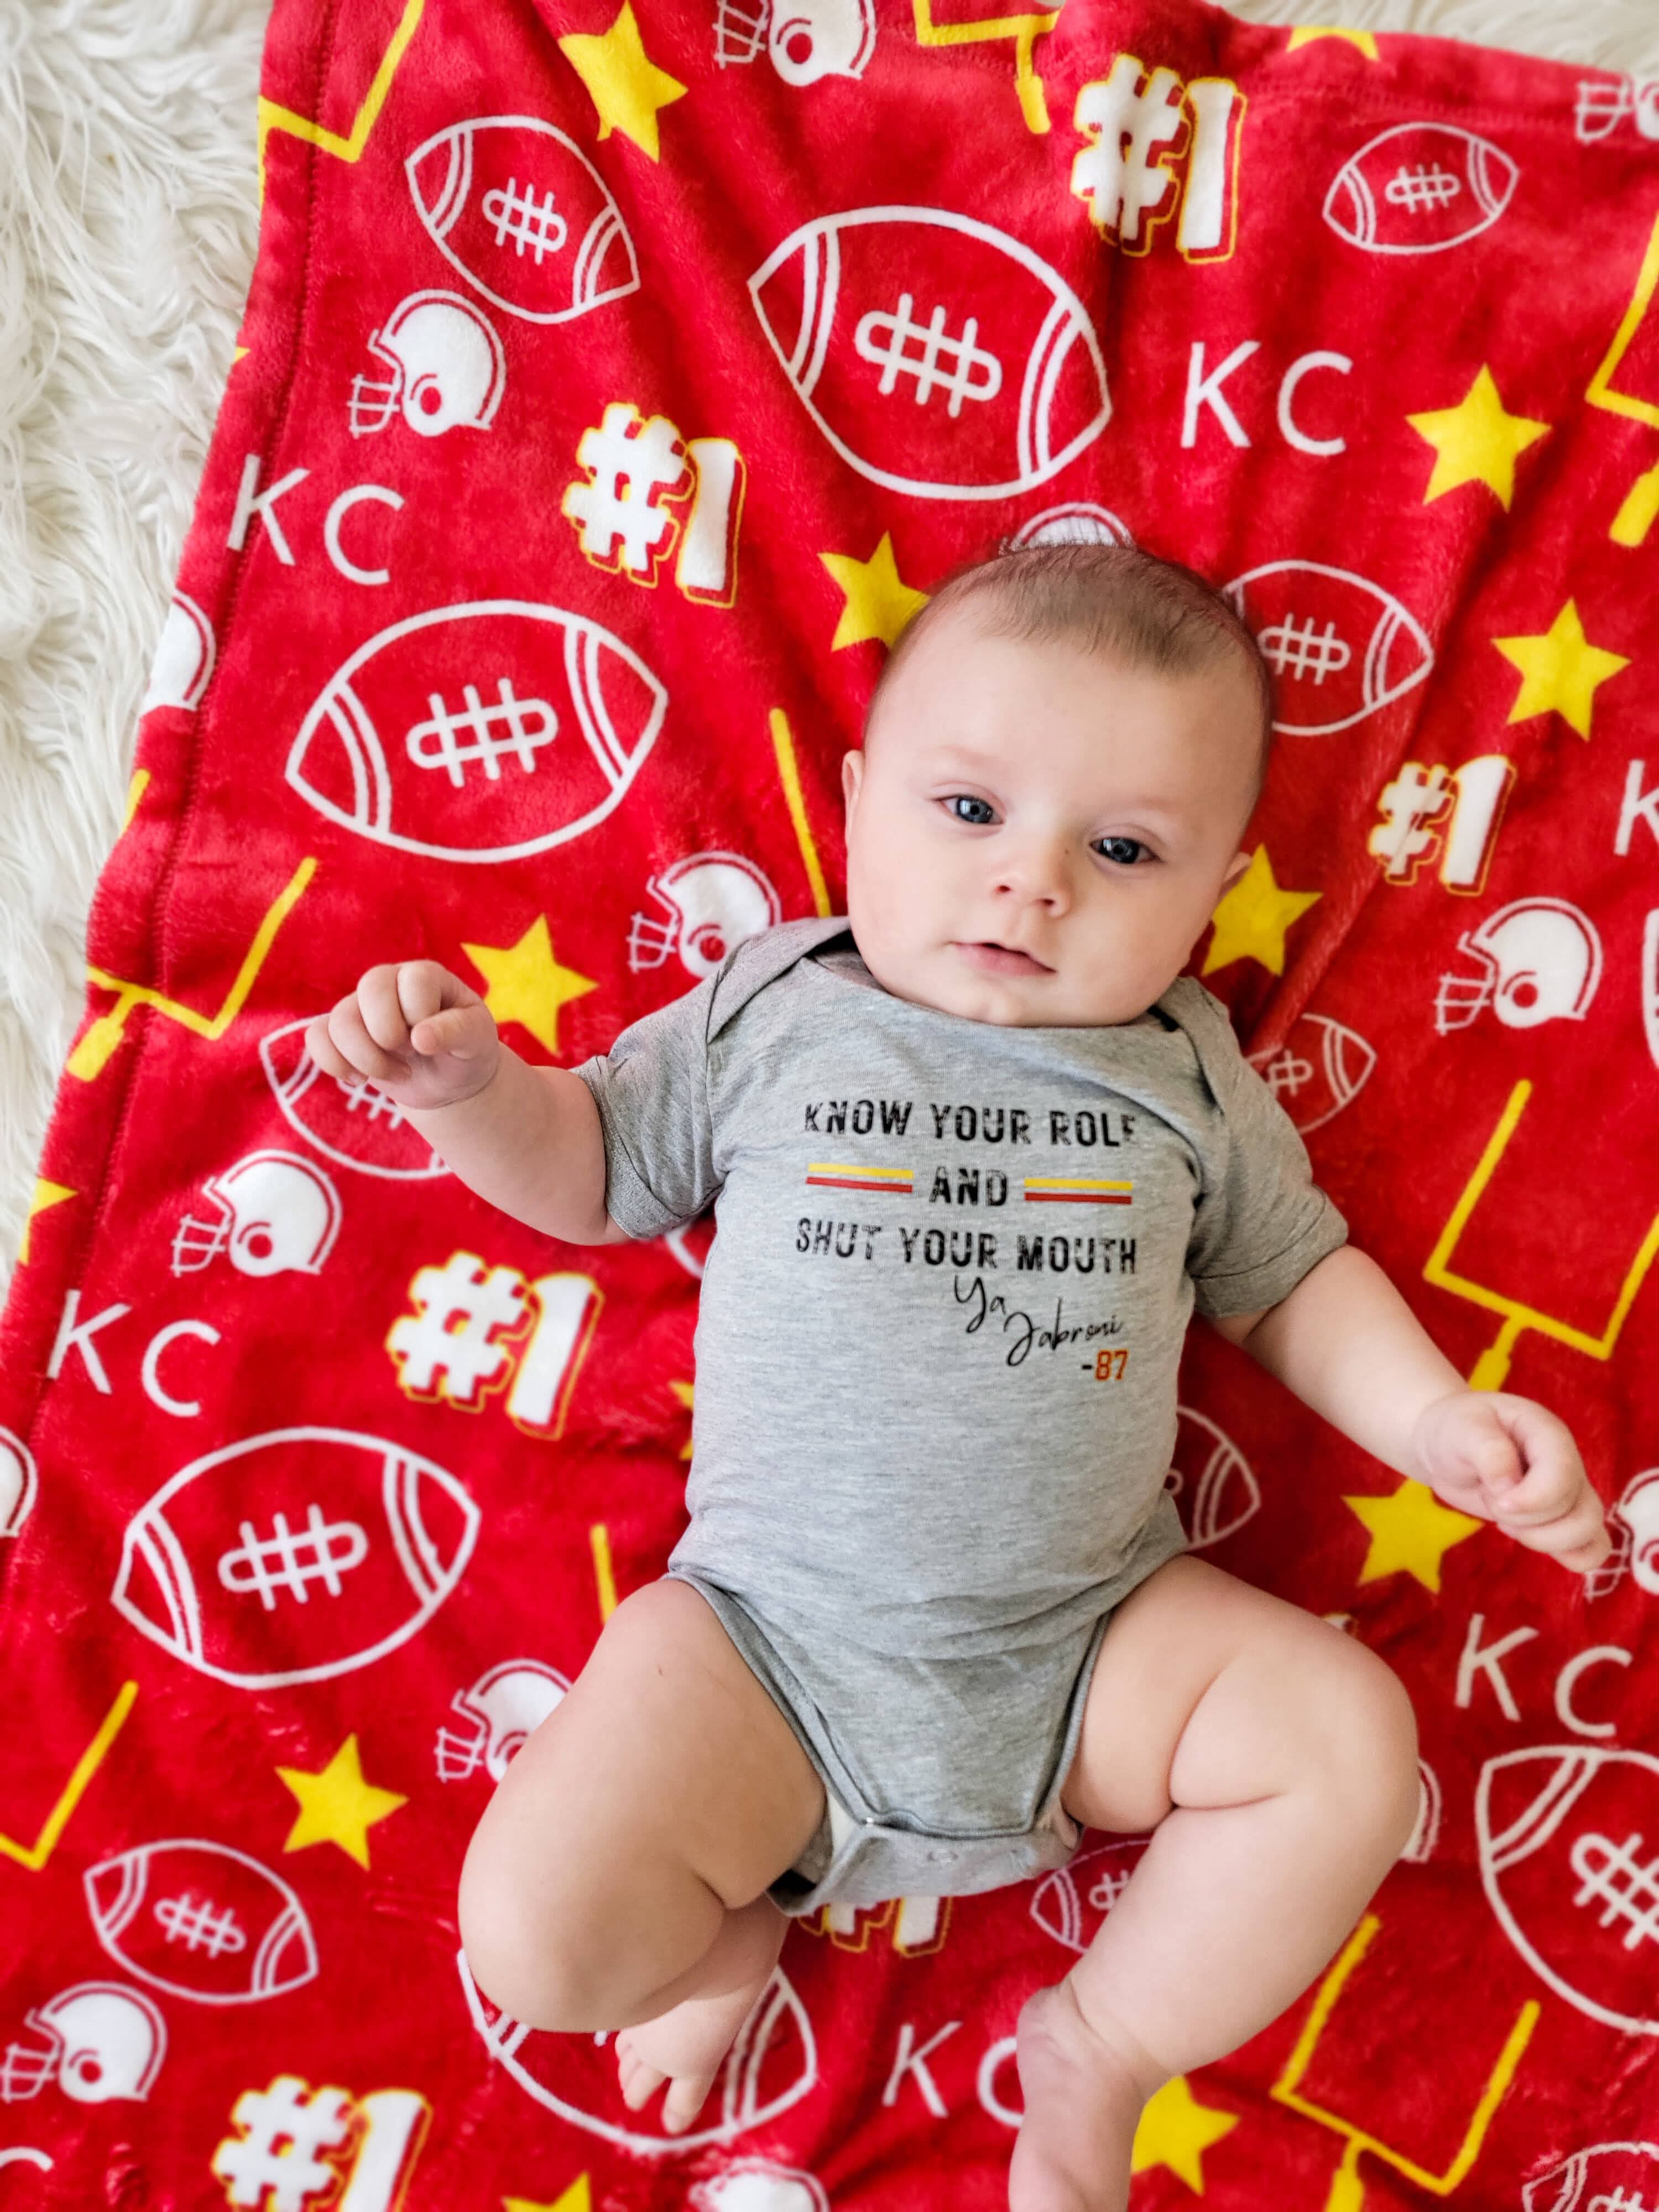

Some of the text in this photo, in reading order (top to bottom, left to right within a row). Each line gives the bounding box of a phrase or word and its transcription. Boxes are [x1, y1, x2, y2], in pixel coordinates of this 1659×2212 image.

[1070, 53, 1249, 265] #1
[560, 401, 747, 609] #1
[1367, 753, 1518, 896] #1
[804, 1099, 1136, 1148] KNOW YOUR ROLE
[928, 1166, 1009, 1207] AND
[796, 1217, 1138, 1275] SHUT YOUR MOUTH
[954, 1274, 1006, 1334] Ya
[385, 1250, 604, 1441] #1
[1081, 1348, 1130, 1381] -87
